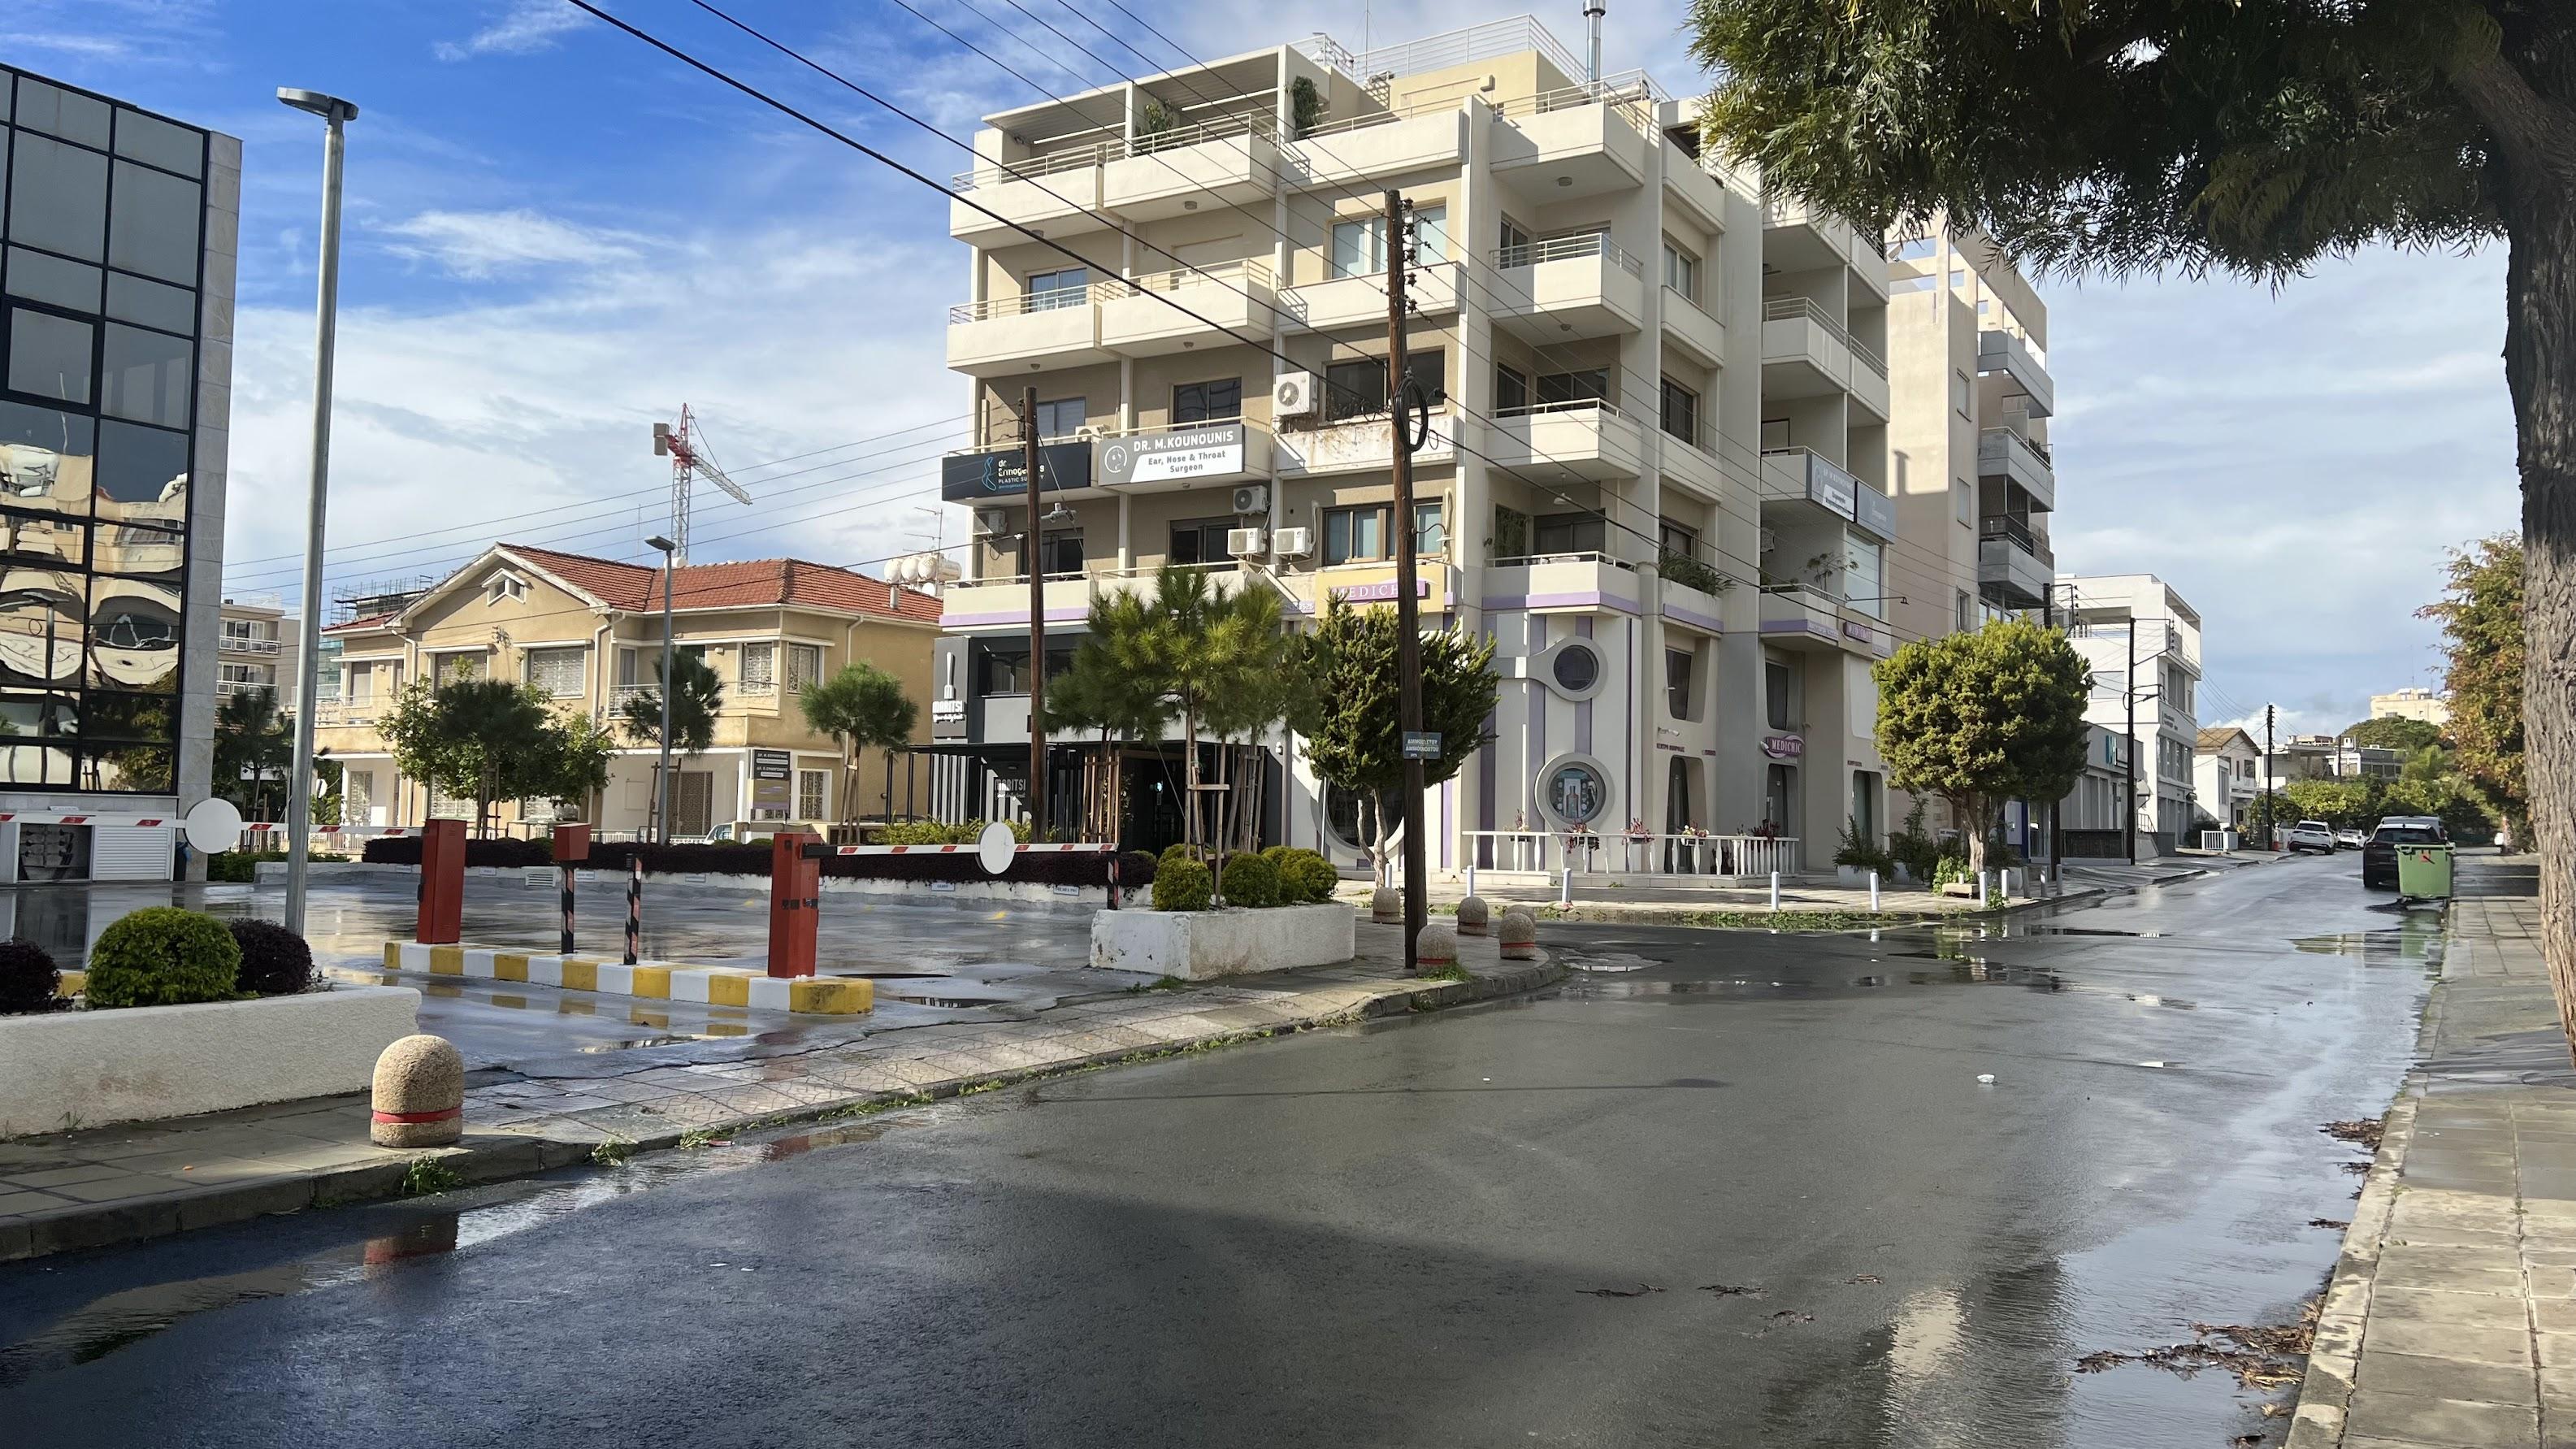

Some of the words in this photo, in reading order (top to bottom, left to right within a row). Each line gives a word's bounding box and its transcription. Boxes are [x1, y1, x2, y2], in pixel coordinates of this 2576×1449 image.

[1134, 440, 1151, 452] DR.
[1155, 431, 1234, 449] M.KOUNOUNIS
[1148, 457, 1164, 466] Ear,
[1167, 454, 1186, 464] Nose
[1189, 453, 1195, 462] &
[1198, 450, 1225, 461] Throat
[998, 464, 1045, 477] Ermoges
[1170, 463, 1203, 473] Surgeon
[1772, 739, 1802, 754] MEDICHIC
